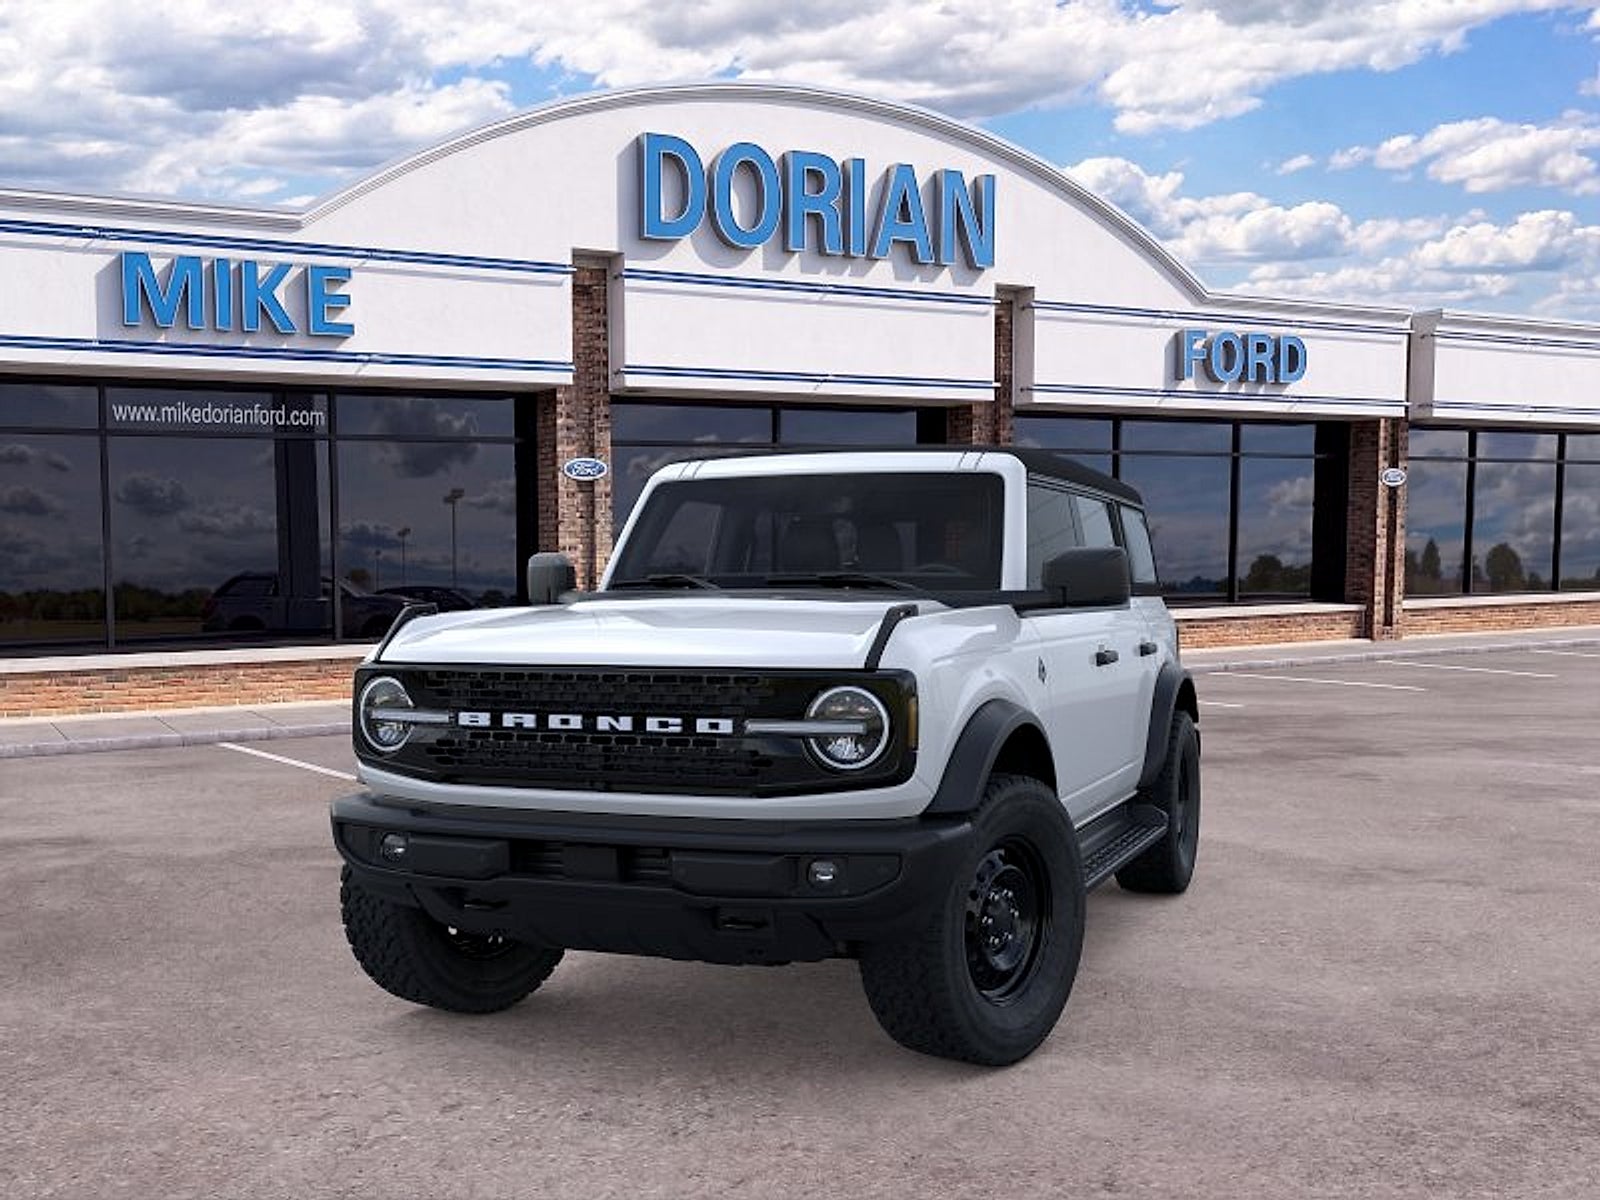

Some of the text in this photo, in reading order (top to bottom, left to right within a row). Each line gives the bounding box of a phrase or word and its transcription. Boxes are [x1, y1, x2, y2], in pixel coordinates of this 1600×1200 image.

[641, 132, 996, 269] DORIAN
[122, 251, 355, 336] MIKE
[1181, 328, 1308, 384] FORD
[112, 401, 325, 426] www.mikedorianford.com
[457, 711, 734, 734] BRONCO
